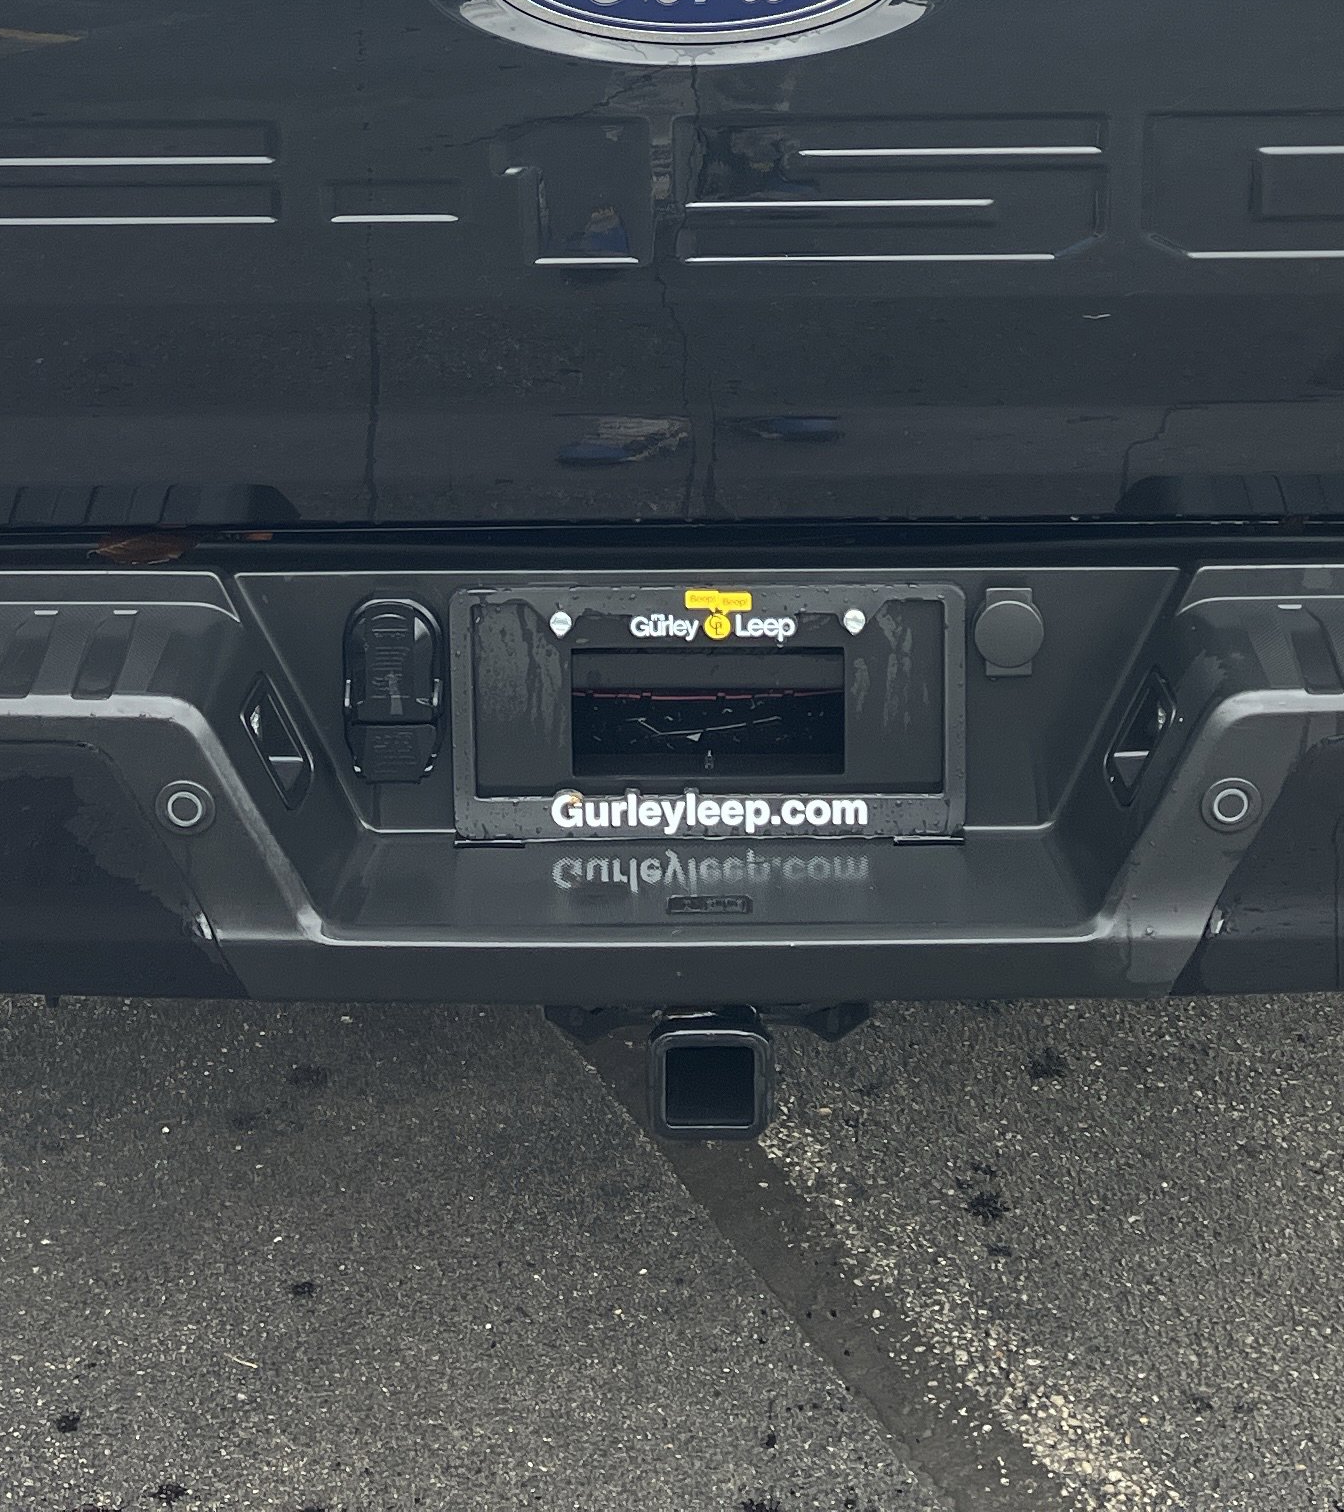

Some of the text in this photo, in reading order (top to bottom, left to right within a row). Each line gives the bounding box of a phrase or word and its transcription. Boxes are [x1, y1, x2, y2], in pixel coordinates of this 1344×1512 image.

[630, 613, 699, 641] Gurley
[735, 613, 796, 642] Leep
[552, 791, 868, 835] Gurleyleep.com
